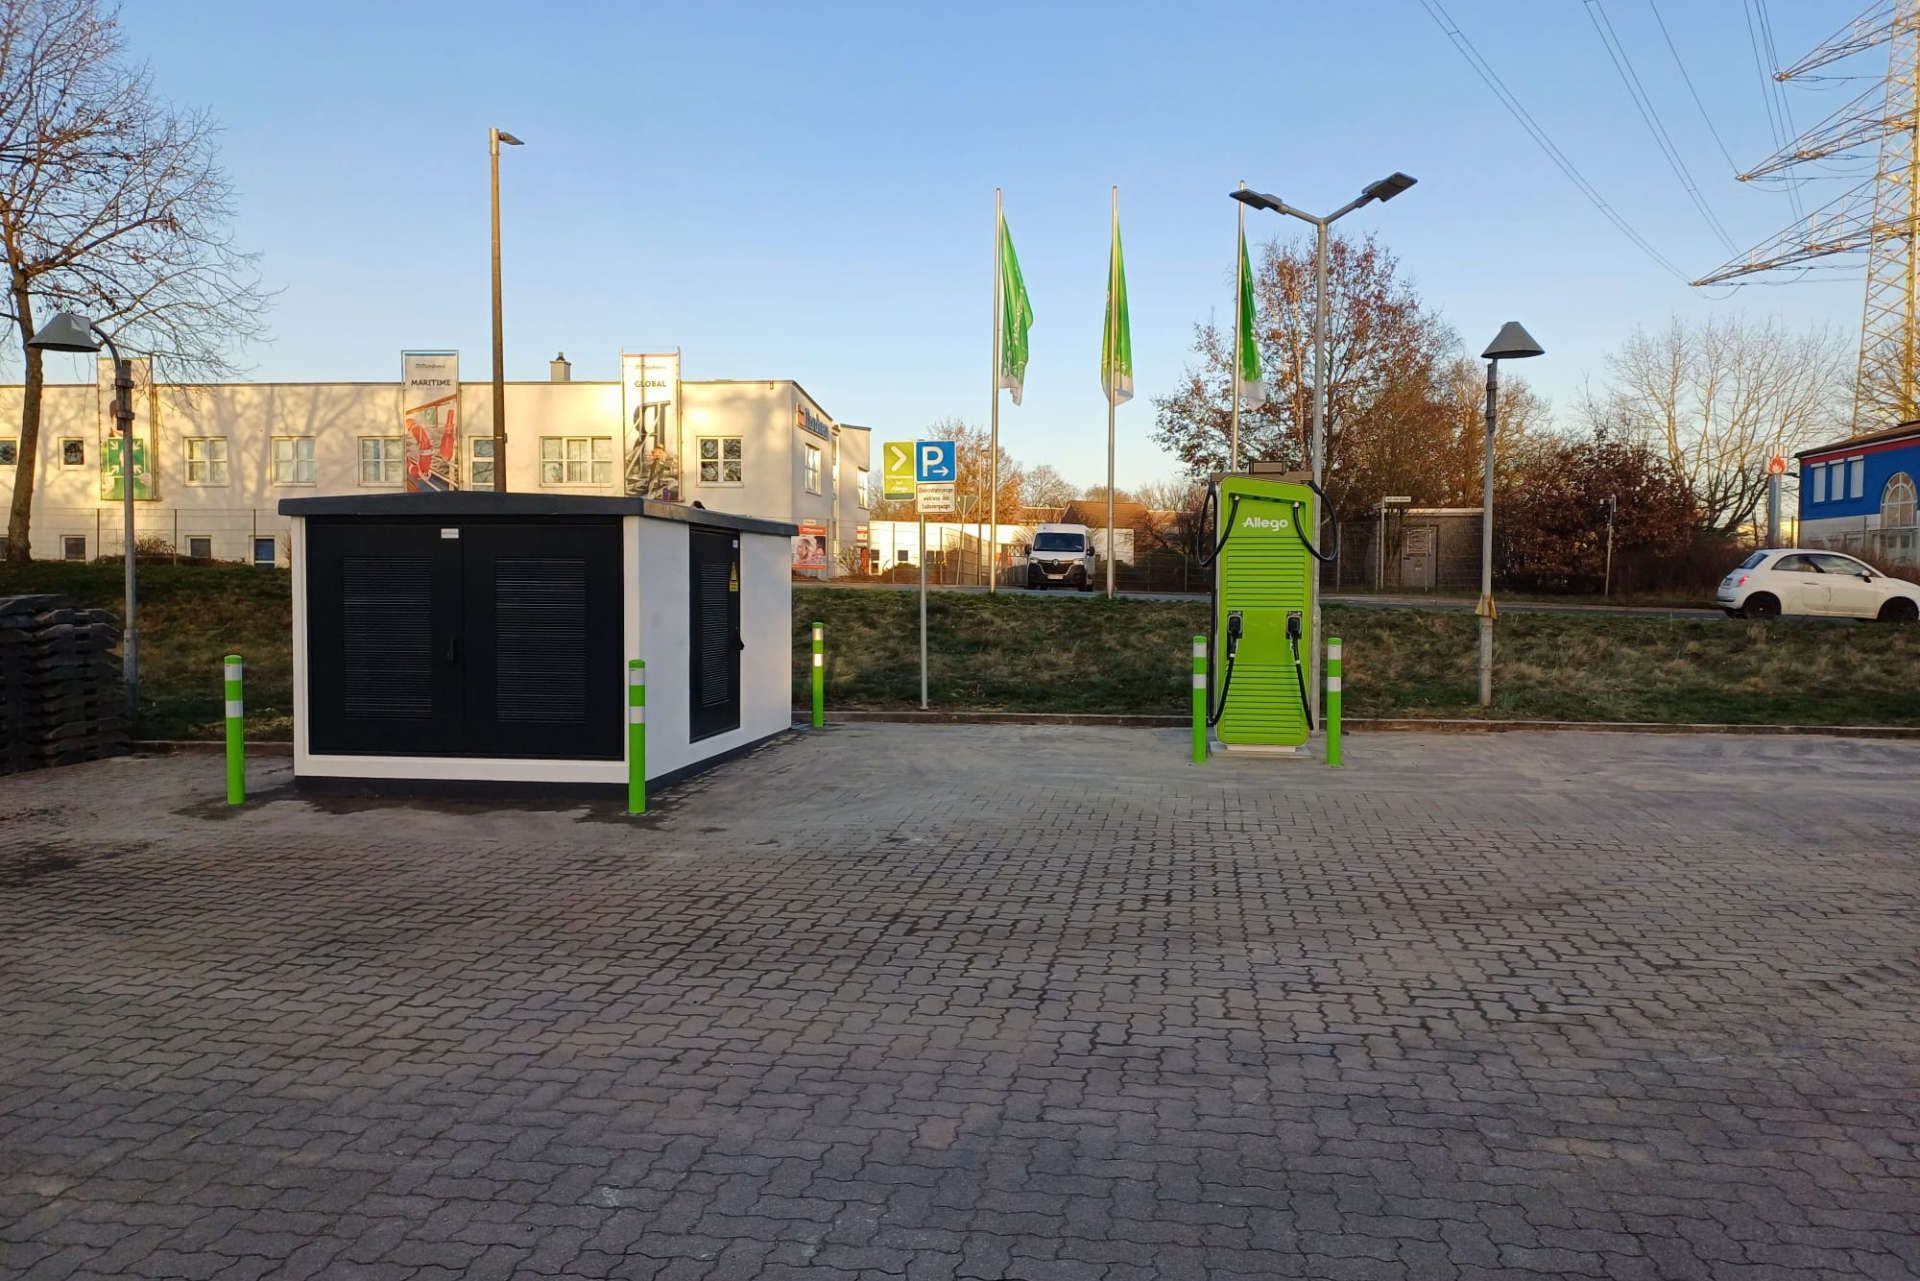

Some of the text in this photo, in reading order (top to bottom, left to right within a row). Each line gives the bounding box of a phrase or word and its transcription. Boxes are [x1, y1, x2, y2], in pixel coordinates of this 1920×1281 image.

[634, 380, 667, 388] GLOBAL
[922, 446, 944, 477] P
[1241, 516, 1289, 532] Allego
